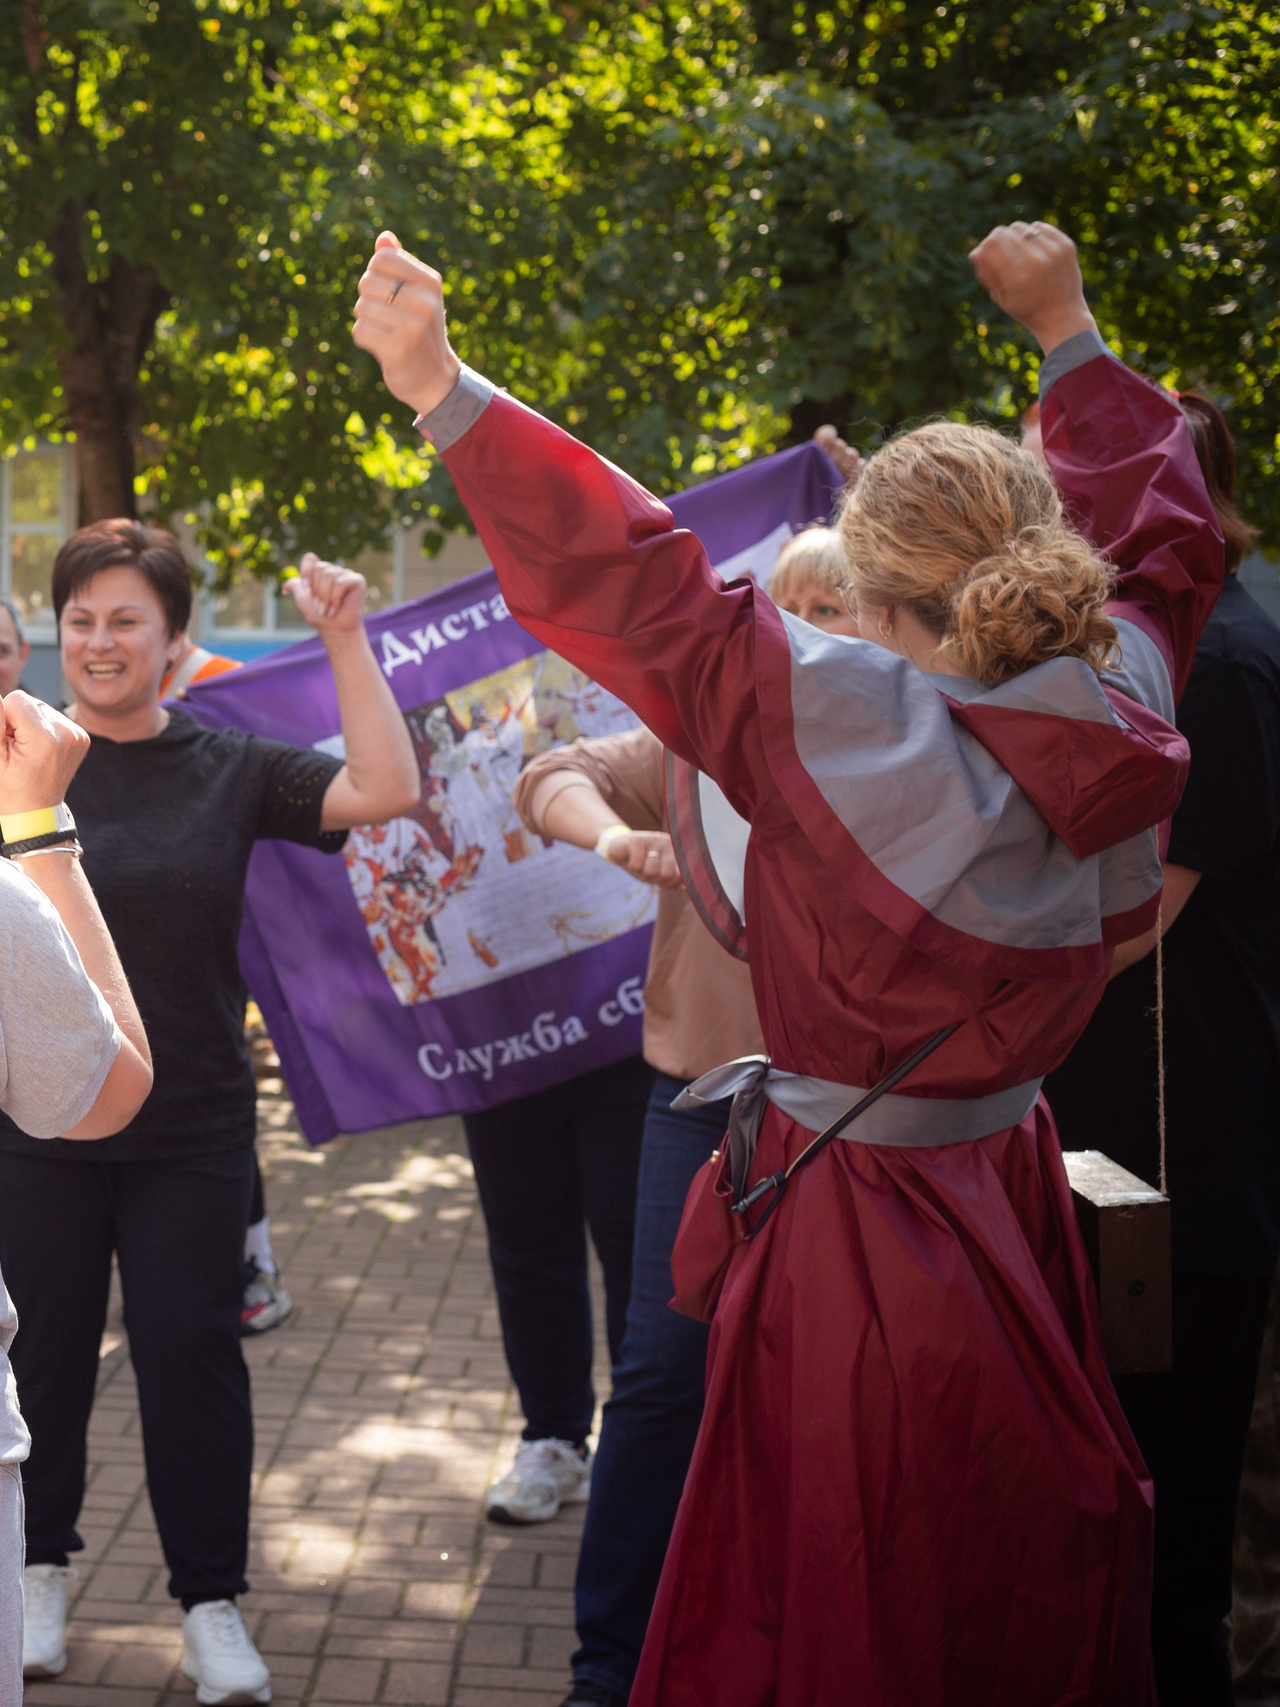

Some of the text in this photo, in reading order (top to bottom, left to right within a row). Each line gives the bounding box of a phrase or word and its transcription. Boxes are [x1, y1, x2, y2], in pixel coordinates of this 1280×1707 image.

[380, 593, 511, 677] Диста
[417, 975, 646, 1081] Служба сб
